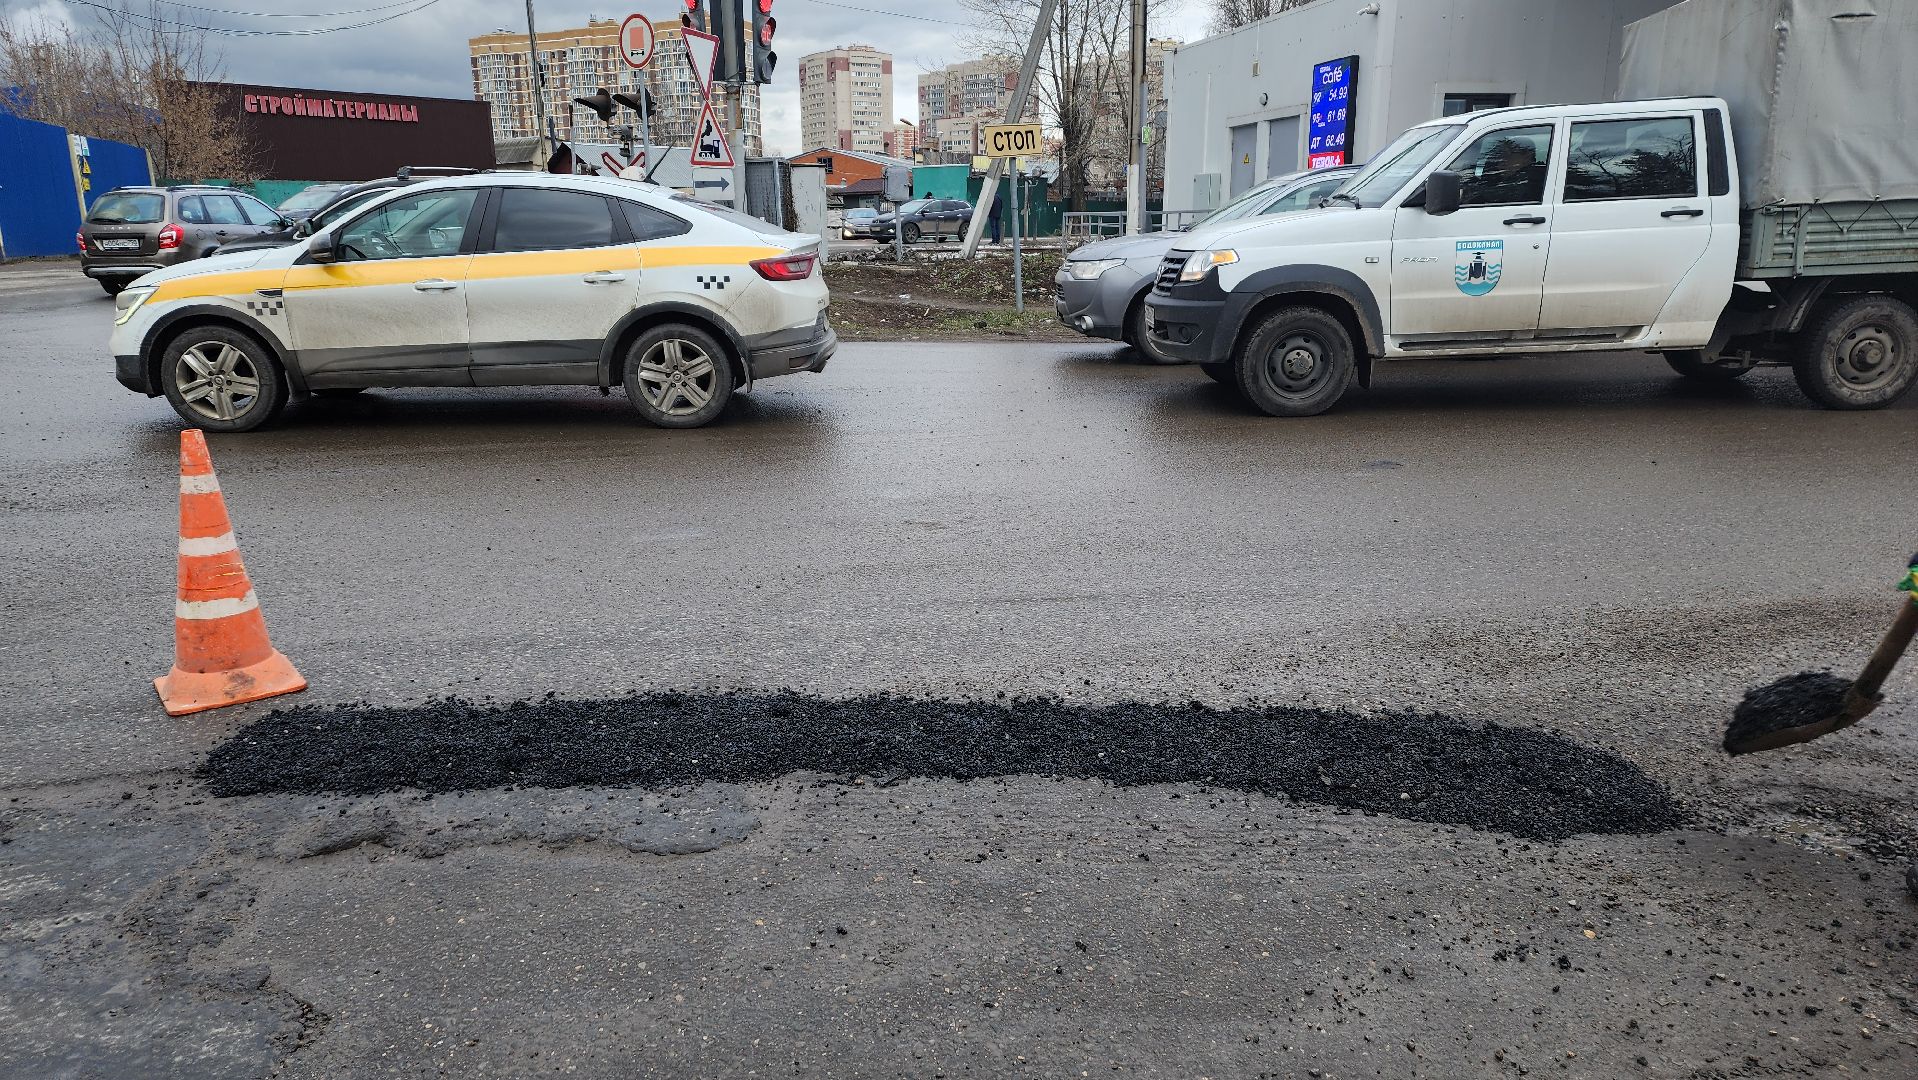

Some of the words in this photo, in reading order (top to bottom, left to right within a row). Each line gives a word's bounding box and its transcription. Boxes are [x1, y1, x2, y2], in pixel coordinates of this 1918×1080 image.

[244, 93, 418, 122] СТРОЙМАТЕРИАЛЫ
[993, 130, 1035, 151] СТОП
[1457, 241, 1500, 250] ВОДОКАНАЛ
